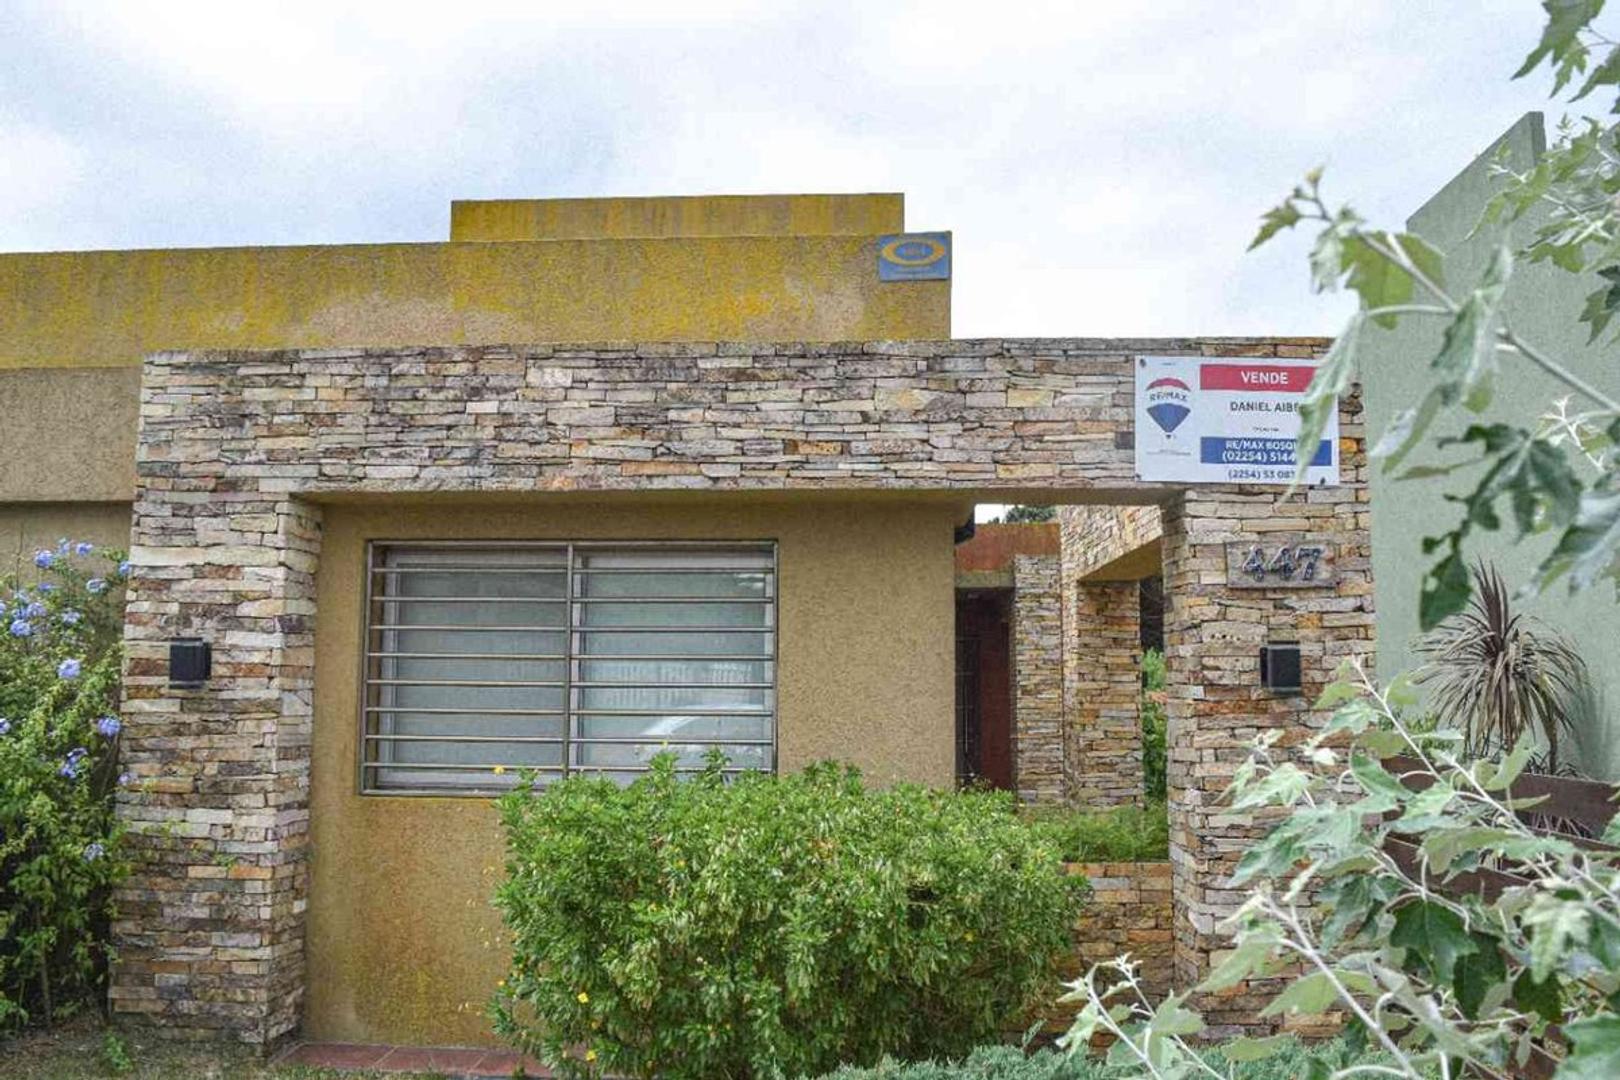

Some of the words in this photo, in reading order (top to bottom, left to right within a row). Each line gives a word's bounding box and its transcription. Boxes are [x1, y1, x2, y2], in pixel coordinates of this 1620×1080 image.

[1240, 370, 1289, 385] VENDE
[1149, 390, 1188, 402] RE/MAX
[1229, 401, 1272, 412] DANIEL
[1225, 439, 1264, 450] RE/MAX
[1222, 450, 1267, 463] (02254)
[1228, 469, 1261, 480] (2254)
[1242, 544, 1323, 583] 447
